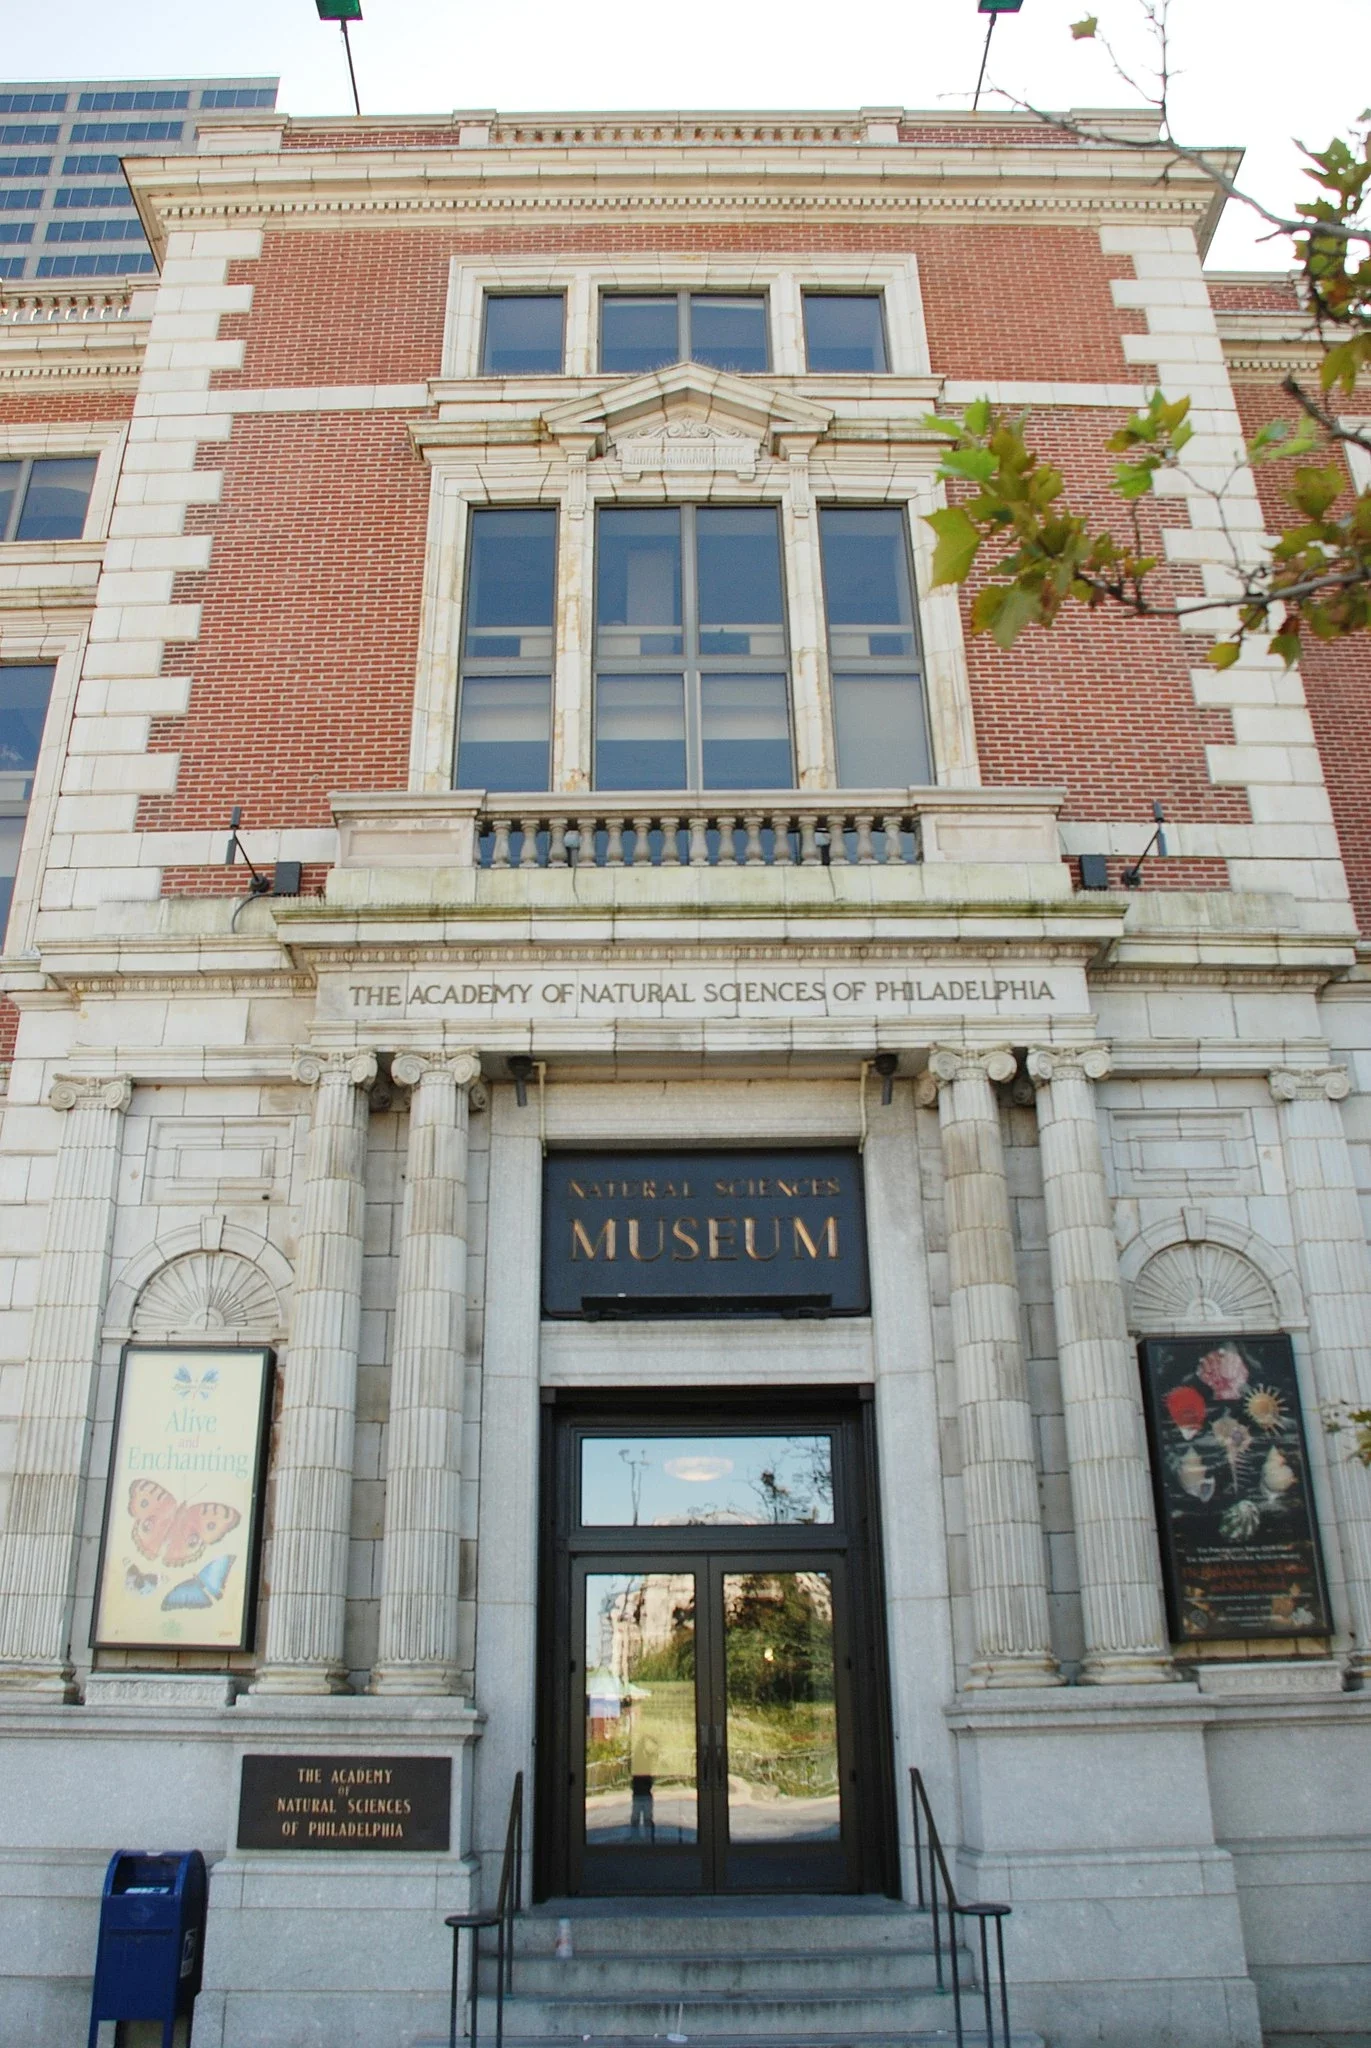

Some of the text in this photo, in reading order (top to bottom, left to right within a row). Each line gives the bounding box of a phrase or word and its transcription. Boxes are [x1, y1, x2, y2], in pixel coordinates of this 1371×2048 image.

[349, 980, 1056, 1006] THE ACADEMY OF NATURAL SCIENCES OF PHILADELPHIA
[569, 1176, 841, 1199] NATURAL SCIENCES
[568, 1215, 843, 1262] MUSEUM
[164, 1407, 218, 1433] Alive
[177, 1435, 200, 1449] and
[127, 1445, 249, 1479] Enchanting
[297, 1768, 393, 1784] THE ACADEMY
[337, 1786, 350, 1797] OF
[276, 1798, 412, 1814] NATURAL SCIENCES
[281, 1821, 404, 1838] OF PHILADELPHIA
